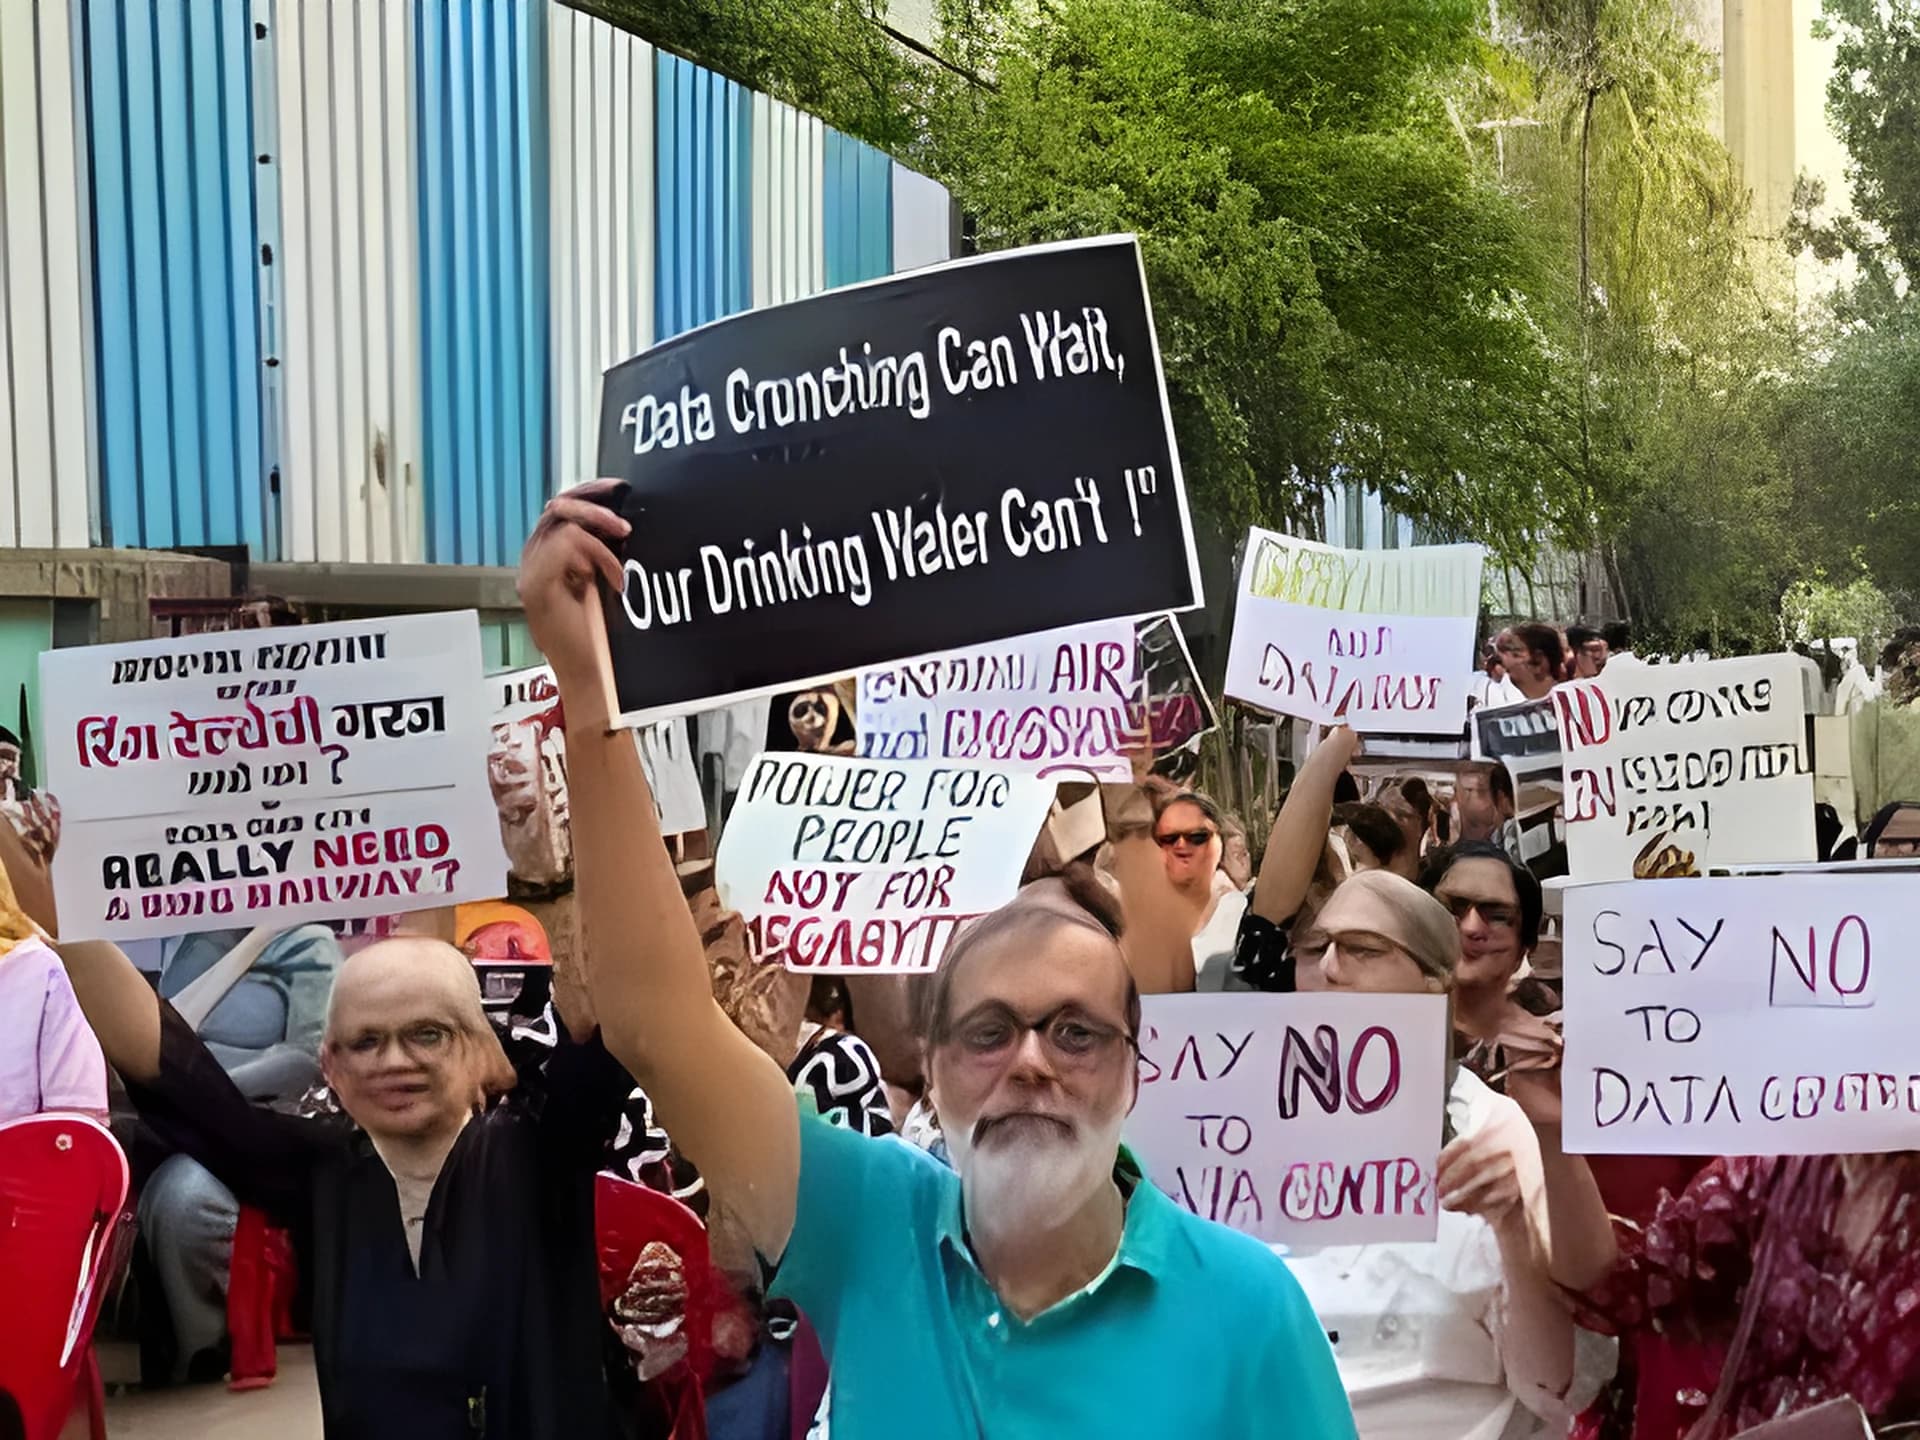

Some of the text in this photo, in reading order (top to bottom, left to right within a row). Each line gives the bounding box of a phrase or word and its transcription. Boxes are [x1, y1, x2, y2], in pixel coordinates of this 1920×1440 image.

[937, 325, 1018, 396] Can
[621, 558, 692, 631] Our
[700, 522, 872, 607] Drinking
[871, 503, 990, 581] Water
[1049, 641, 1130, 700] AIR
[792, 813, 974, 864] PEOPLE
[763, 863, 957, 912] NOT FOR
[1593, 910, 1871, 1006] SAY NO
[1624, 1005, 1702, 1043] TO
[1278, 1024, 1402, 1120] NO
[1591, 1066, 1742, 1128] DATA
[1184, 1115, 1252, 1156] TO
